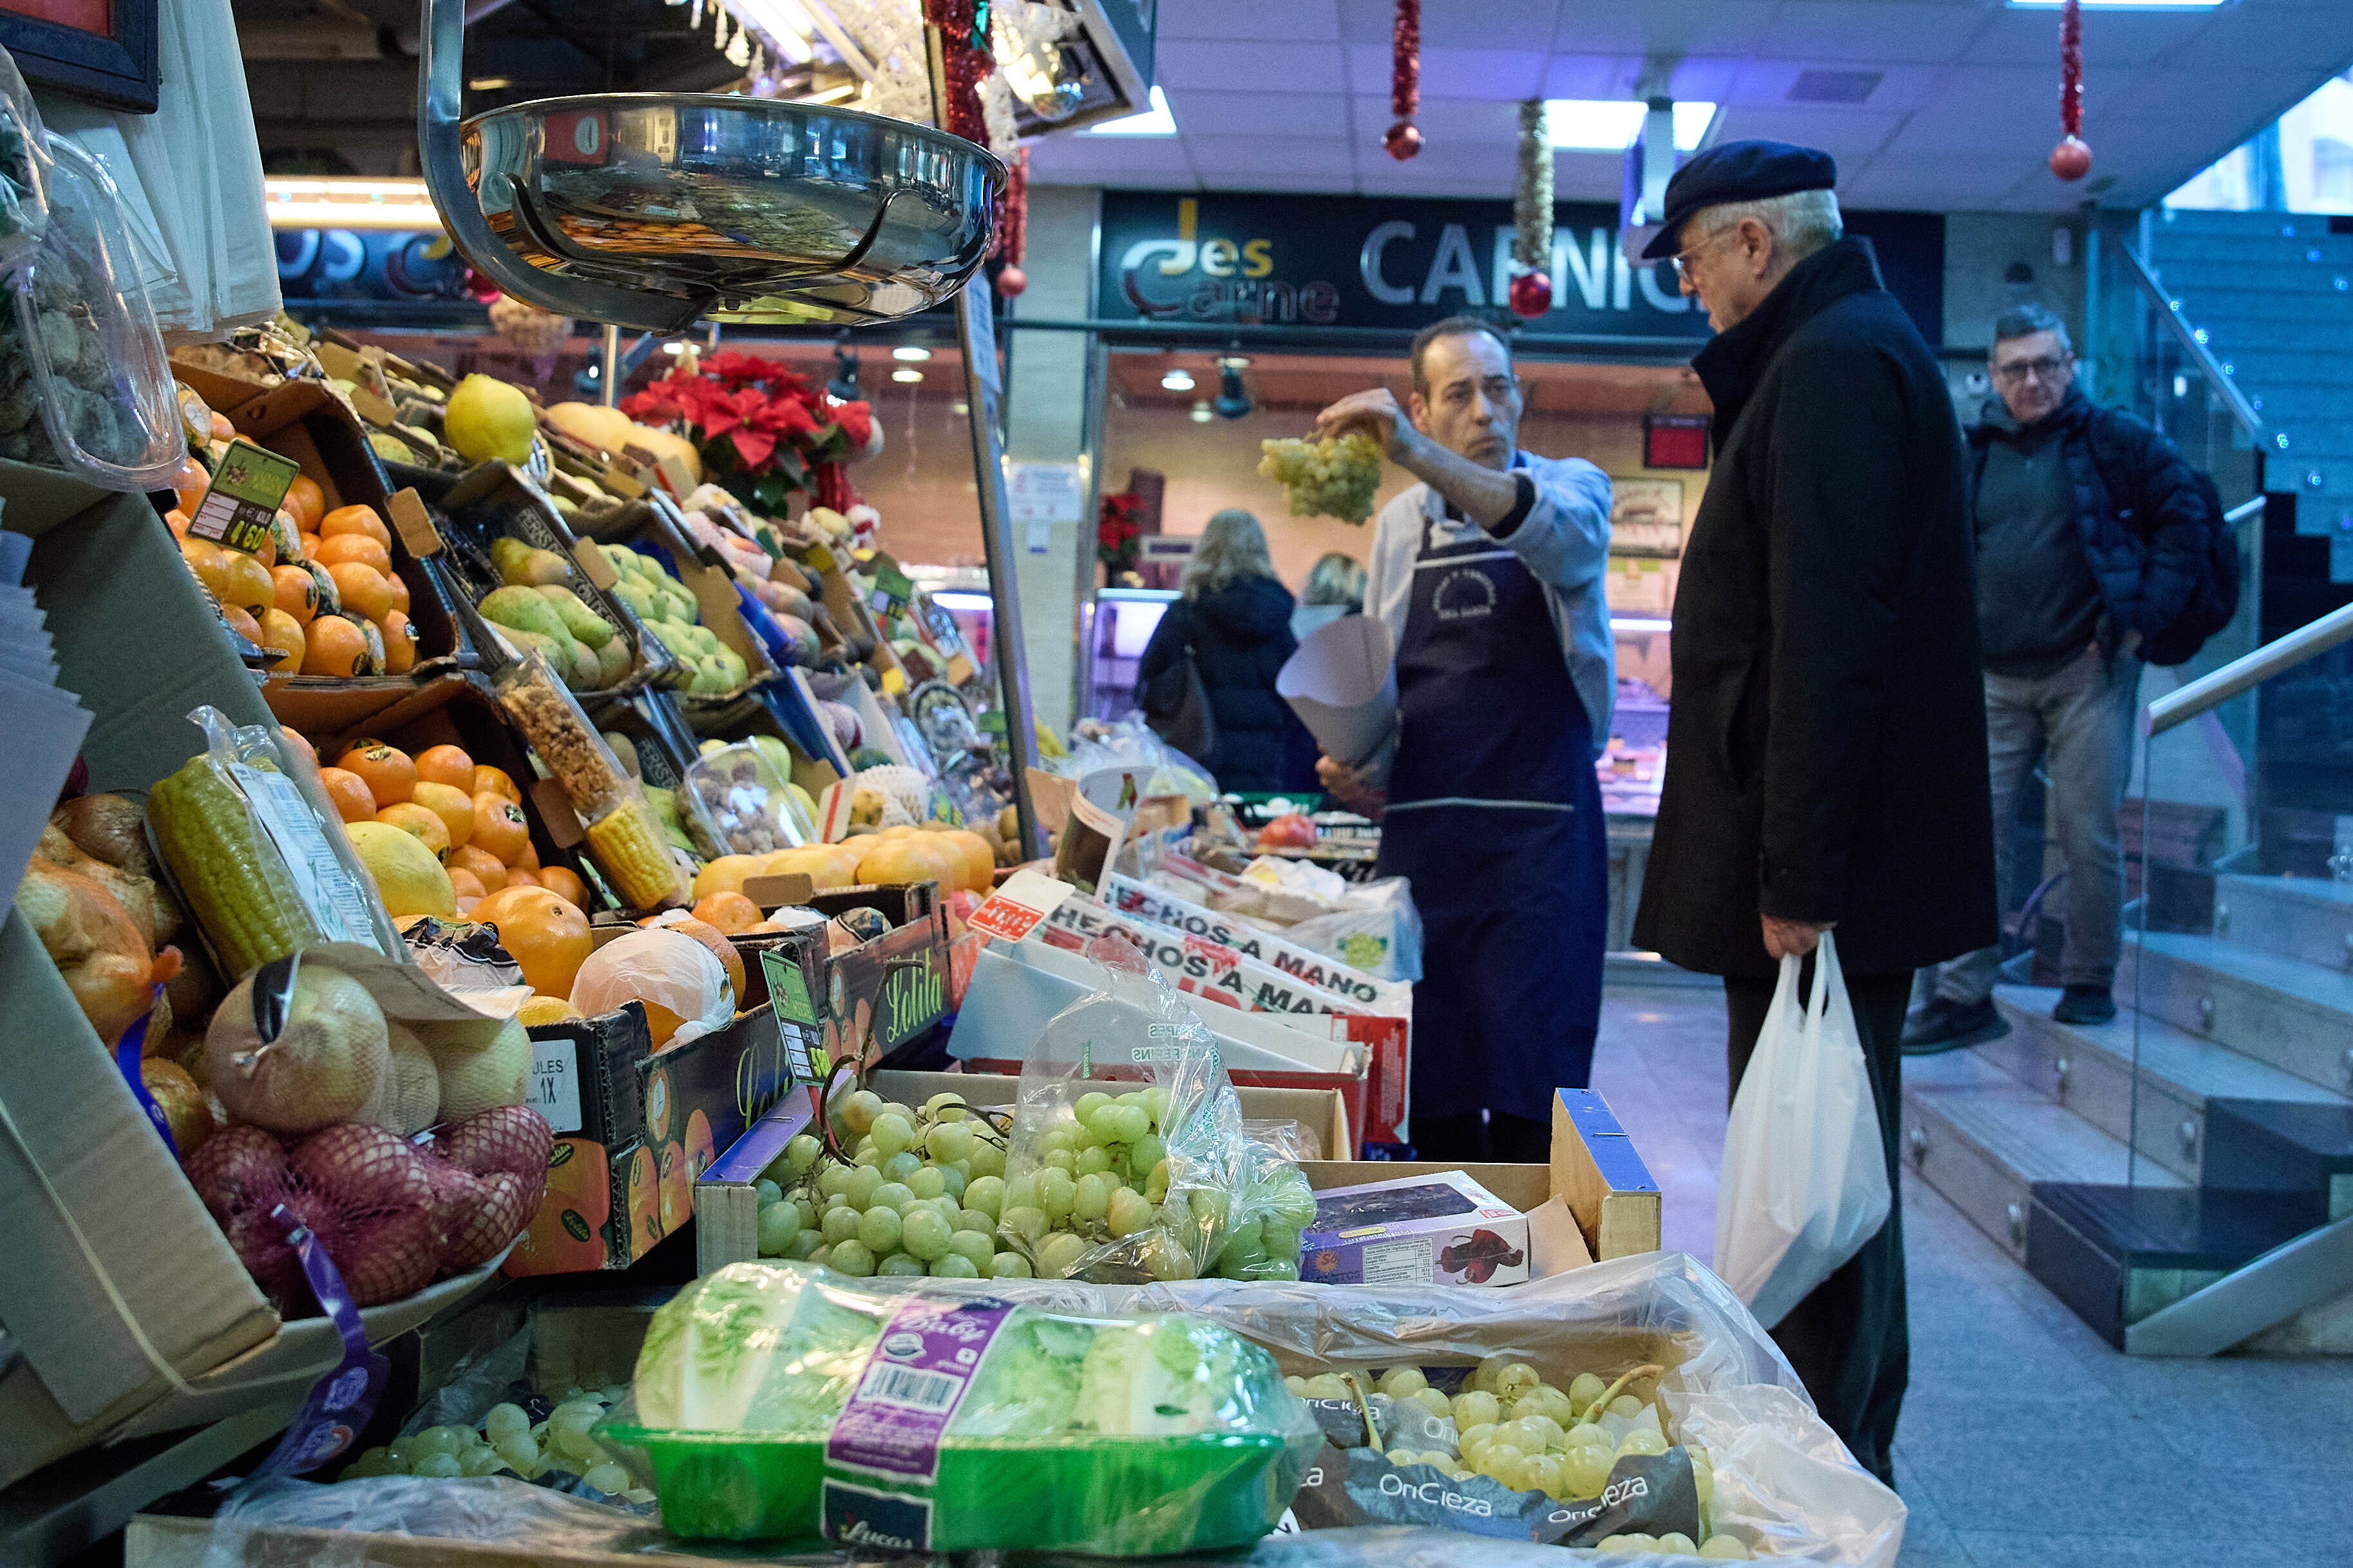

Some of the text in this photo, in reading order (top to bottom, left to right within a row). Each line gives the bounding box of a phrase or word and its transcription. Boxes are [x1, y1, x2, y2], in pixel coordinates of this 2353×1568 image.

[1218, 970, 1243, 994] A
[1241, 939, 1262, 960] A
[1273, 950, 1378, 1003] MANO
